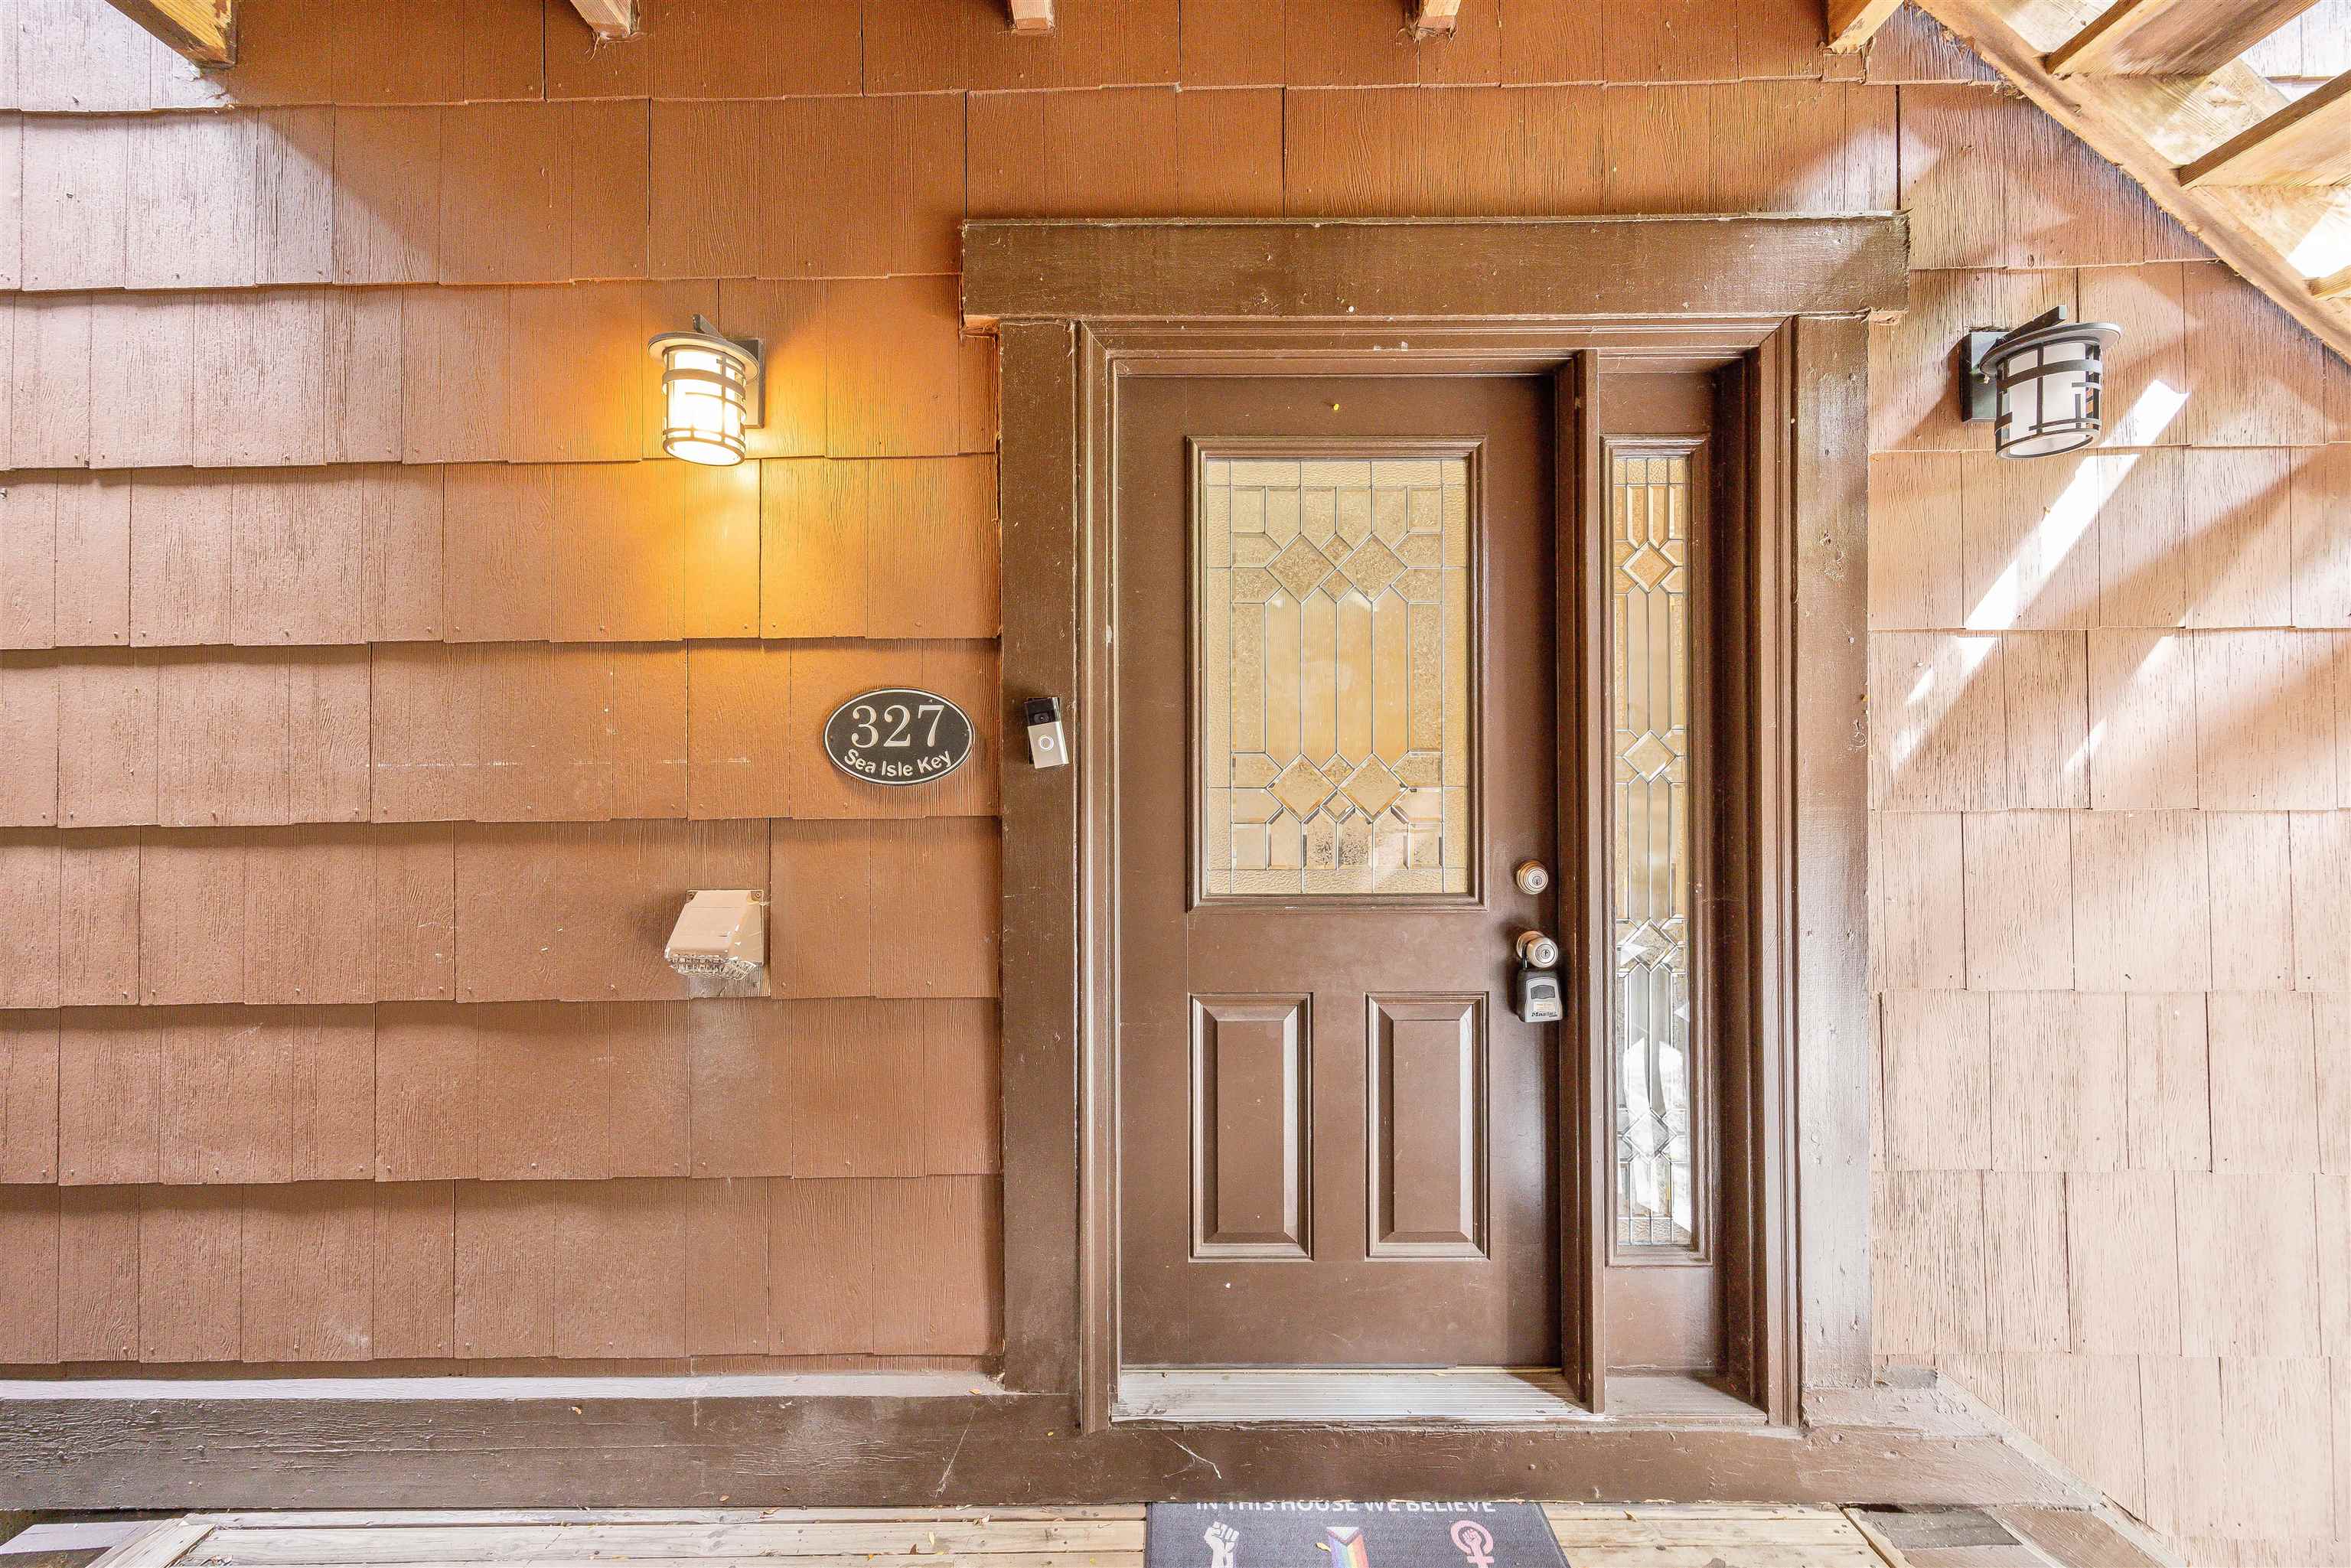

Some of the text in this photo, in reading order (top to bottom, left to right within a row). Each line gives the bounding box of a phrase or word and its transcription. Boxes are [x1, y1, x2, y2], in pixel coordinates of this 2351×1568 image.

[851, 704, 944, 748] 327
[844, 749, 951, 777] Sea Isle Key
